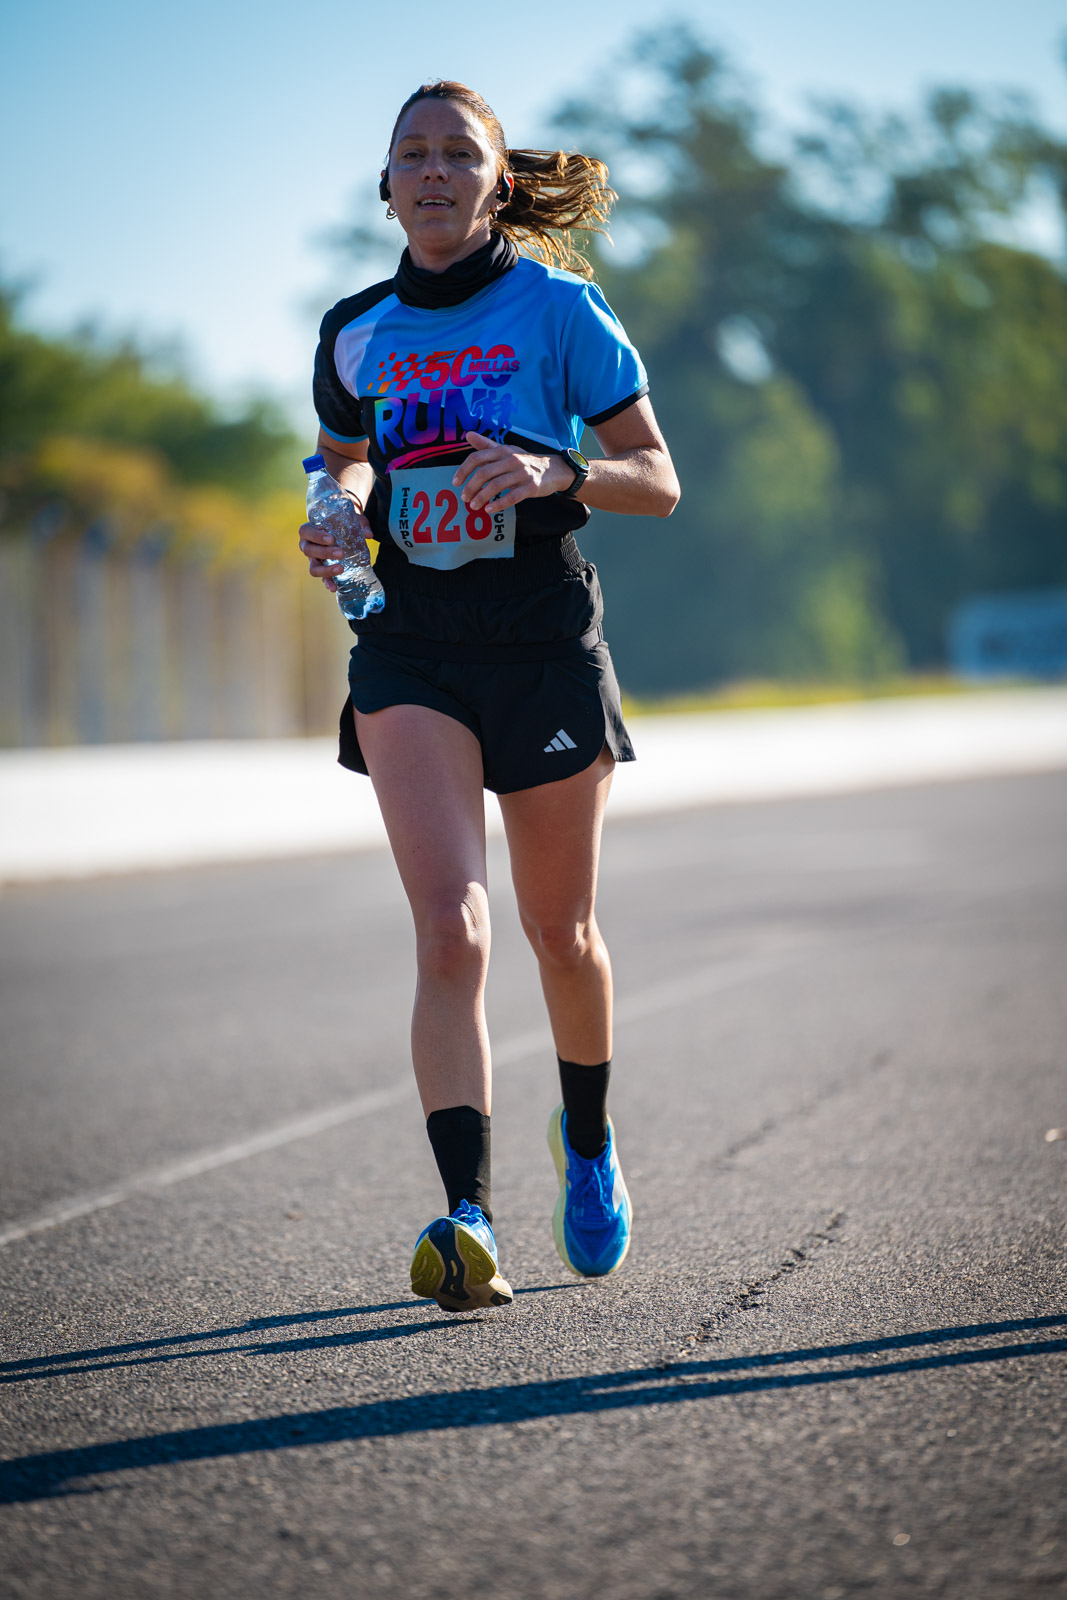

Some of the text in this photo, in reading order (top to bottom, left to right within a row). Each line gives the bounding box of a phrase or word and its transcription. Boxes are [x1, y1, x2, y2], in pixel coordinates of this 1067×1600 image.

[420, 344, 516, 390] 500
[468, 360, 520, 373] MILLAS
[374, 388, 490, 455] RUN
[398, 487, 414, 548] TIEMPO
[412, 488, 493, 544] 228
